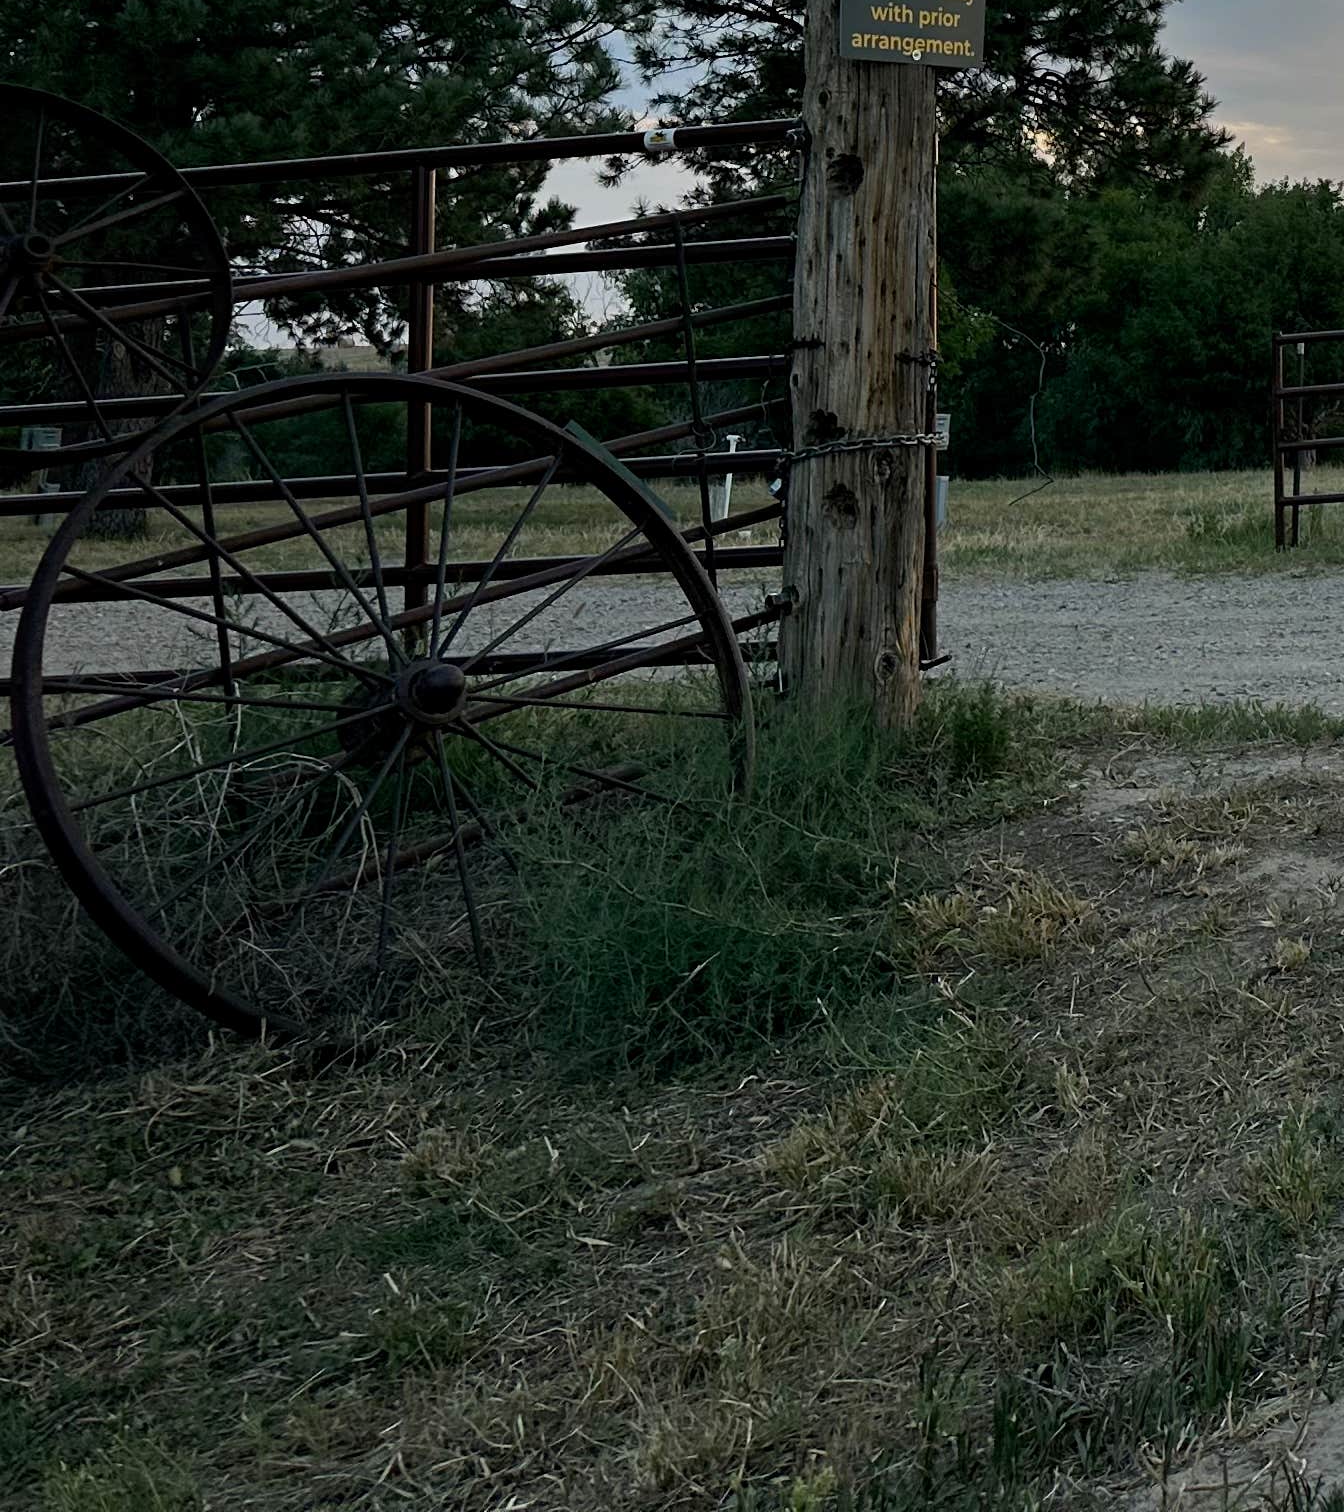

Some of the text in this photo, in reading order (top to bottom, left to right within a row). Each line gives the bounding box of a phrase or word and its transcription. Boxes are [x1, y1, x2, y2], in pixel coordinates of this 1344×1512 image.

[871, 2, 960, 29] with prior
[851, 32, 975, 56] arrangement.
